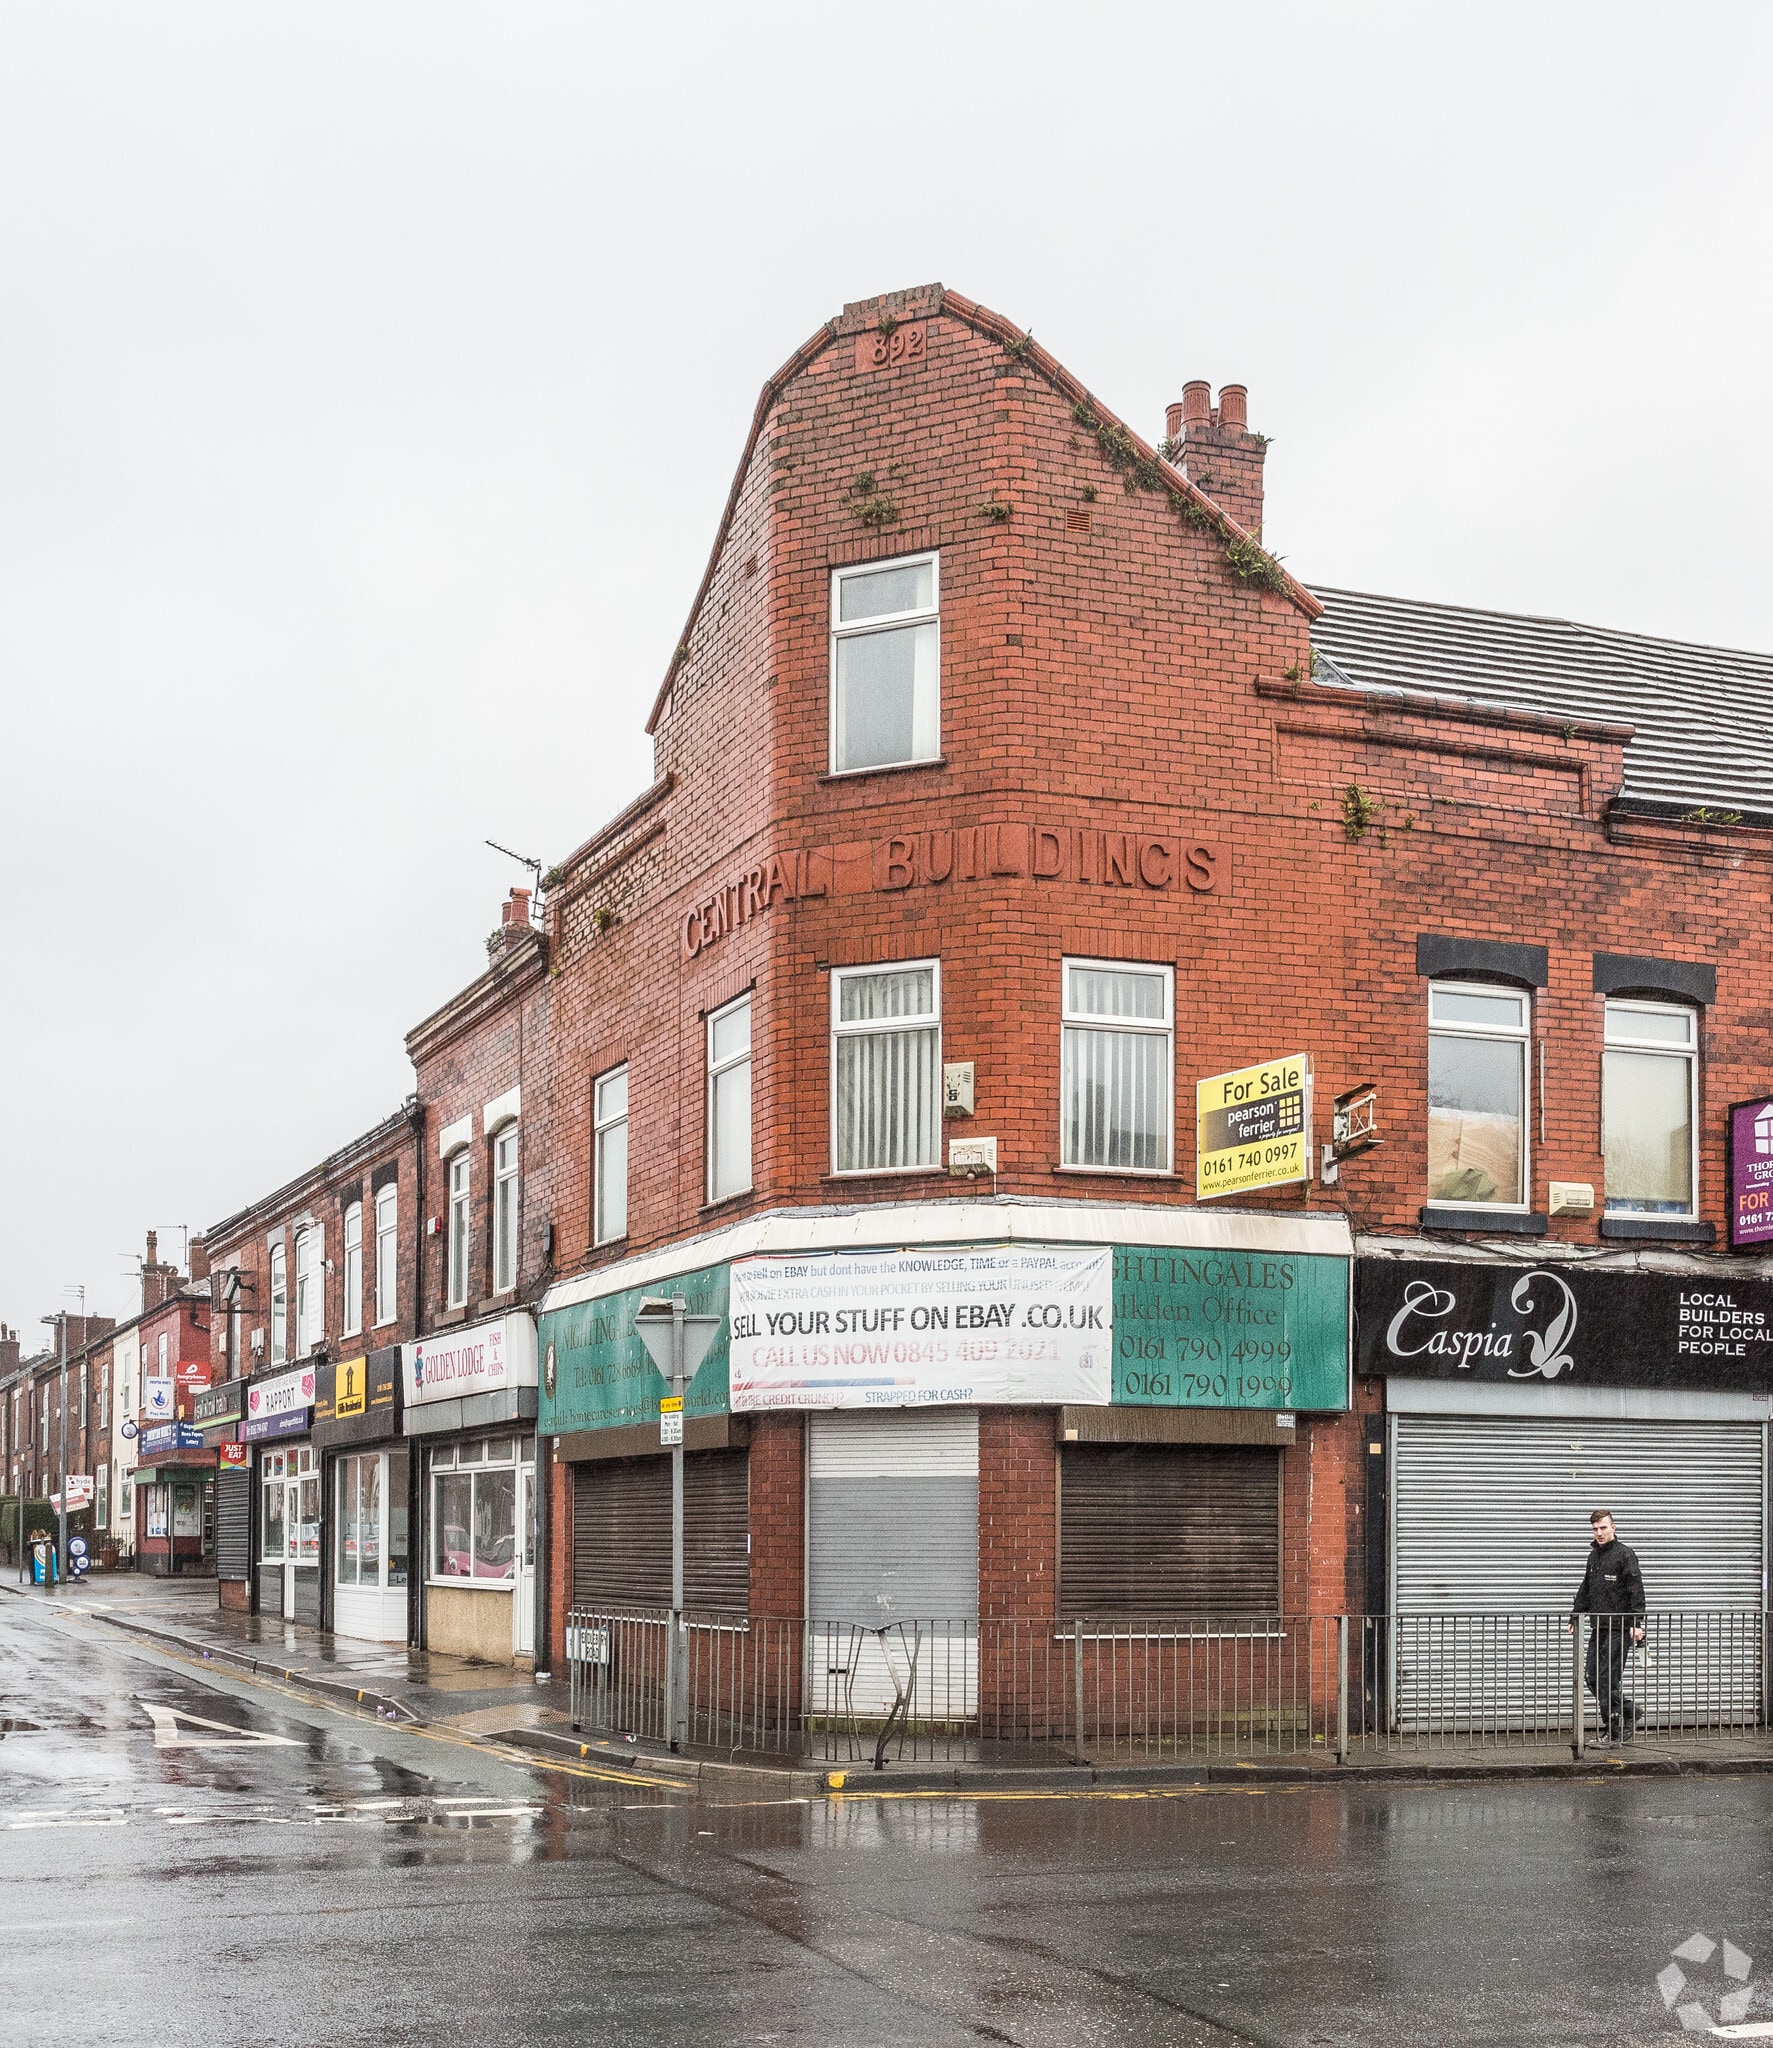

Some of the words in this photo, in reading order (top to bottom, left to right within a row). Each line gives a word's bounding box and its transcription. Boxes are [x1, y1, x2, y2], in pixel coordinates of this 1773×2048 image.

[680, 848, 829, 958] CENTRAL
[1223, 1078, 1254, 1104] For
[1260, 1067, 1299, 1094] Sale
[1228, 1103, 1274, 1127] pearson
[1238, 1119, 1275, 1139] ferrier
[1203, 1158, 1232, 1177] 0161
[1238, 1150, 1261, 1170] 740
[1265, 1142, 1298, 1165] 0997
[1202, 1163, 1300, 1191] www.pearsonferrier.co.uk
[1739, 1191, 1769, 1211] FOR
[1739, 1213, 1762, 1226] 0161
[770, 1270, 782, 1279] on
[784, 1265, 809, 1278] EBAY
[811, 1264, 827, 1276] but
[829, 1263, 852, 1275] dont
[854, 1262, 878, 1274] have
[880, 1261, 896, 1273] the
[899, 1258, 967, 1272] KNOWLEDGE,
[970, 1257, 996, 1269] TIME
[1021, 1257, 1058, 1270] PAYPAL
[778, 1287, 809, 1300] EXTRA
[811, 1286, 837, 1299] CASH
[838, 1286, 848, 1298] IN
[850, 1284, 878, 1297] YOUR
[880, 1282, 920, 1295] POCKET
[921, 1281, 934, 1294] BY
[936, 1280, 975, 1293] SELLING
[978, 1279, 1007, 1292] YOUR
[1680, 1292, 1737, 1308] LOCAL
[1202, 1296, 1277, 1326] Office
[1679, 1308, 1765, 1325] BUILDERS
[734, 1313, 761, 1340] SELL
[766, 1310, 830, 1336] YOUR
[835, 1307, 905, 1333] STUFF
[911, 1306, 948, 1331] ON
[956, 1304, 1016, 1329] EBAY
[1022, 1304, 1104, 1329] .CO.UK
[1386, 1280, 1512, 1369] Caspia
[489, 1332, 502, 1347] FISH
[1678, 1324, 1714, 1339] FOR
[1719, 1326, 1773, 1342] LOCAL
[752, 1345, 799, 1368] CALL
[802, 1344, 829, 1367] US
[834, 1342, 890, 1365] NOW
[894, 1340, 950, 1363] 0845
[1119, 1335, 1165, 1360] 0161
[1176, 1336, 1222, 1362] 790
[1230, 1339, 1292, 1364] 4999
[1678, 1340, 1746, 1356] PEOPLE
[425, 1351, 456, 1384] GOLDEN
[457, 1344, 485, 1378] LODGE
[488, 1362, 504, 1377] CHIPS
[1125, 1371, 1171, 1396] 0161
[1183, 1373, 1228, 1399] 790
[1237, 1376, 1293, 1398] 1999
[265, 1387, 296, 1414] RAPPORT
[763, 1391, 796, 1405] CREDIT
[798, 1390, 845, 1405] CRUNCH?
[865, 1390, 917, 1404] STRAPPED
[918, 1389, 938, 1402] FOR
[940, 1388, 973, 1401] CASH?
[225, 1444, 243, 1452] JUST
[228, 1451, 243, 1459] EAT
[76, 1478, 91, 1488] hyde
